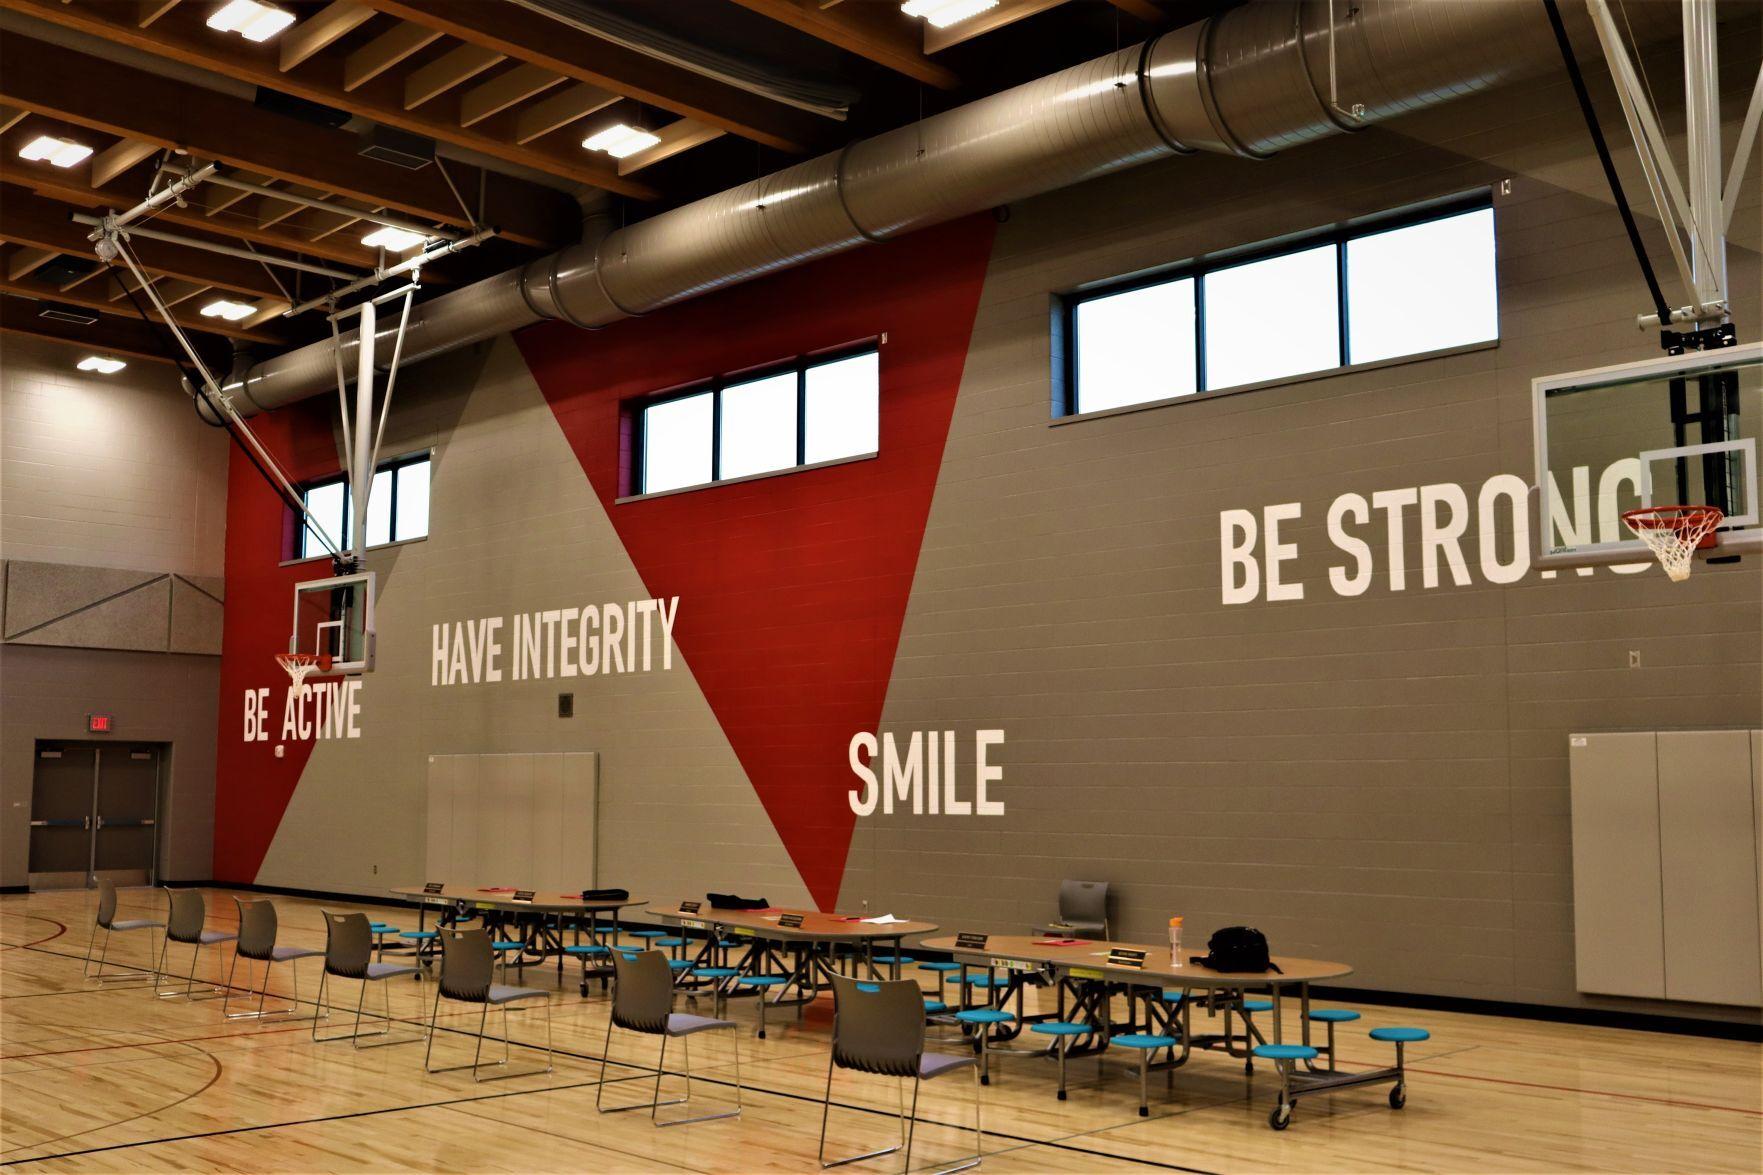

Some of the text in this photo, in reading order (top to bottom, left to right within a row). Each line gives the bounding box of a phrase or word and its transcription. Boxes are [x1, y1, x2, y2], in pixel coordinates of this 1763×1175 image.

[1220, 502, 1304, 605] BE
[431, 596, 680, 686] HAVE INTEGRITY
[92, 716, 109, 729] EXIT
[243, 680, 362, 742] BE ACTIVE
[848, 729, 1005, 816] SMILE
